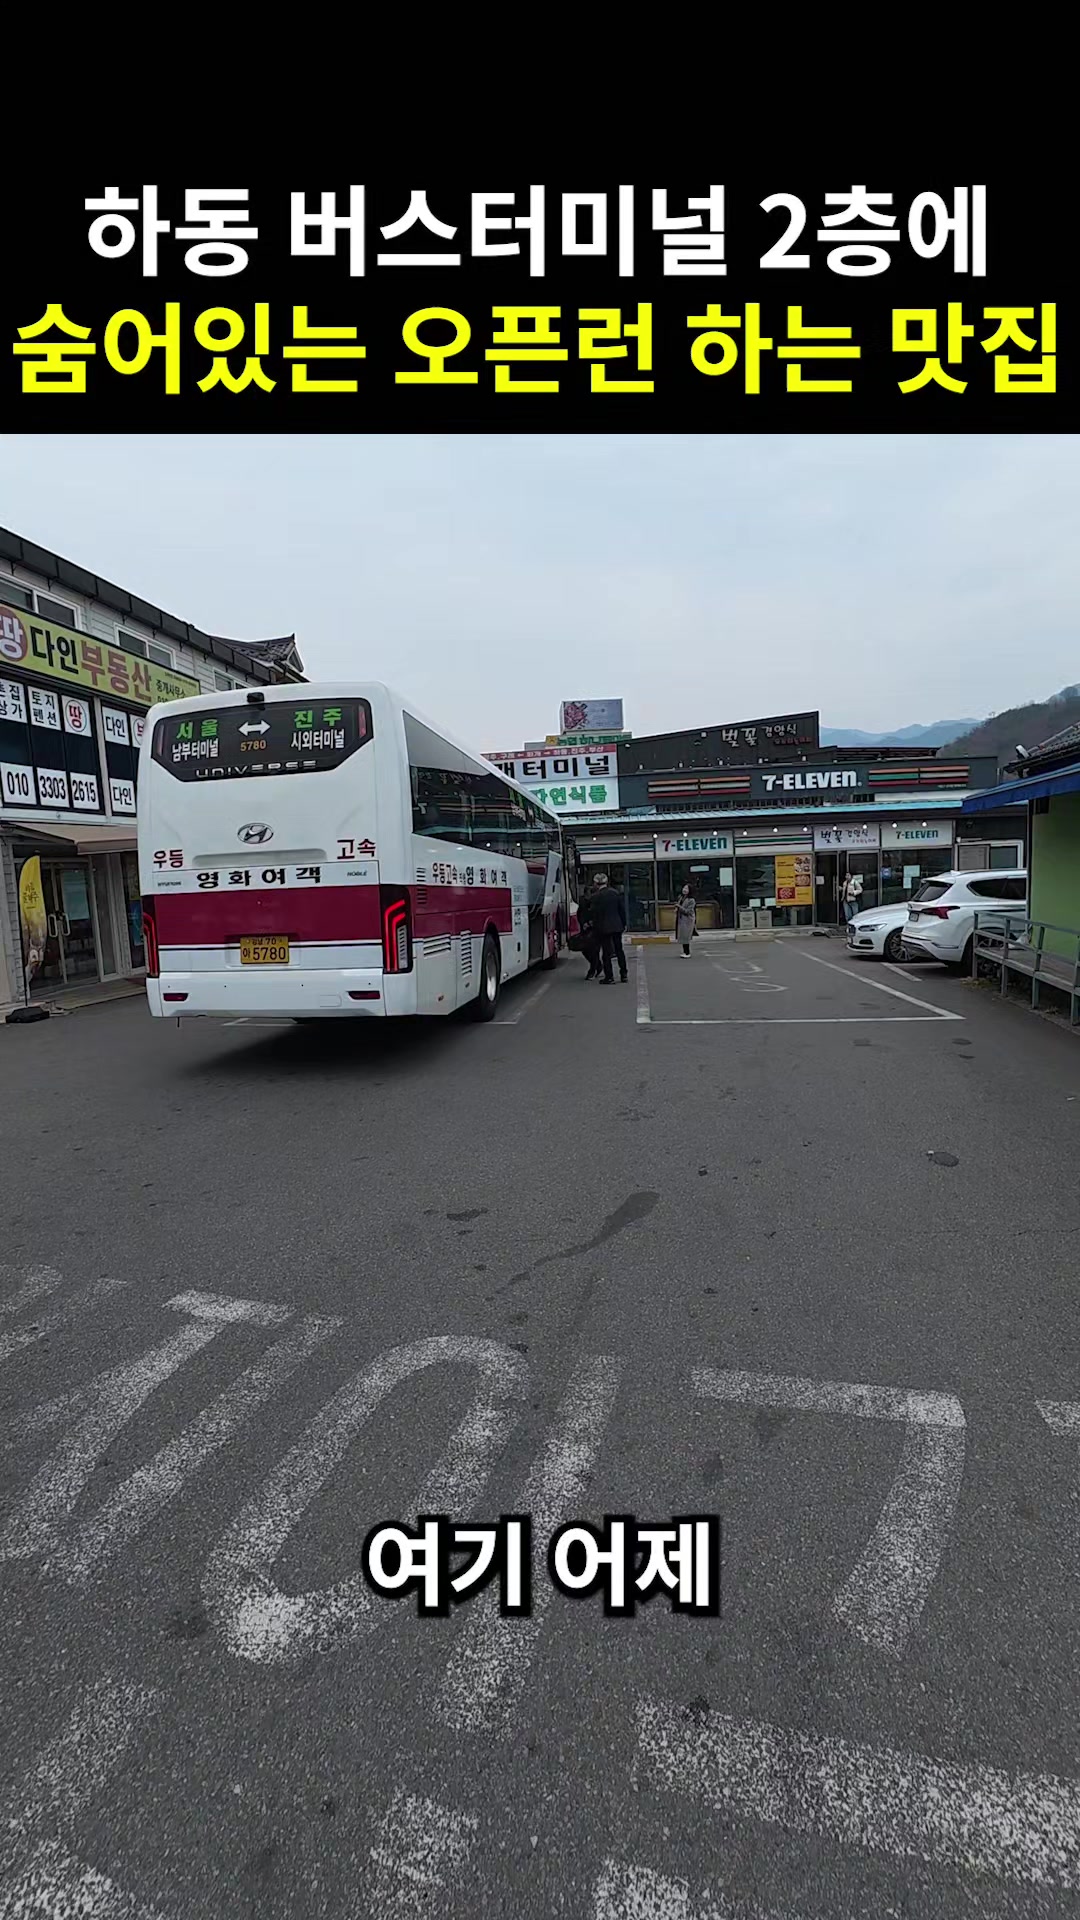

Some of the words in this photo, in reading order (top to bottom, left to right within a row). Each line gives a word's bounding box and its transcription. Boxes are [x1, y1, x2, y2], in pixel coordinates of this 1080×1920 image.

[32, 690, 56, 710] 토지
[68, 705, 83, 728] 땅
[106, 715, 126, 738] 다인
[294, 708, 342, 729] 진주
[176, 719, 219, 739] 서울
[291, 729, 345, 750] 시외터미널
[172, 738, 219, 762] 남부터미널
[240, 740, 267, 751] 5780
[196, 760, 317, 778] UNIVERSE
[7, 771, 29, 796] 010
[39, 775, 66, 799] 3303
[72, 780, 97, 802] 2615
[113, 785, 133, 806] 다인
[153, 849, 184, 869] 우등
[336, 839, 377, 860] 고속
[196, 866, 322, 889] 영화여객
[265, 936, 277, 945] 70
[252, 947, 287, 961] 5780
